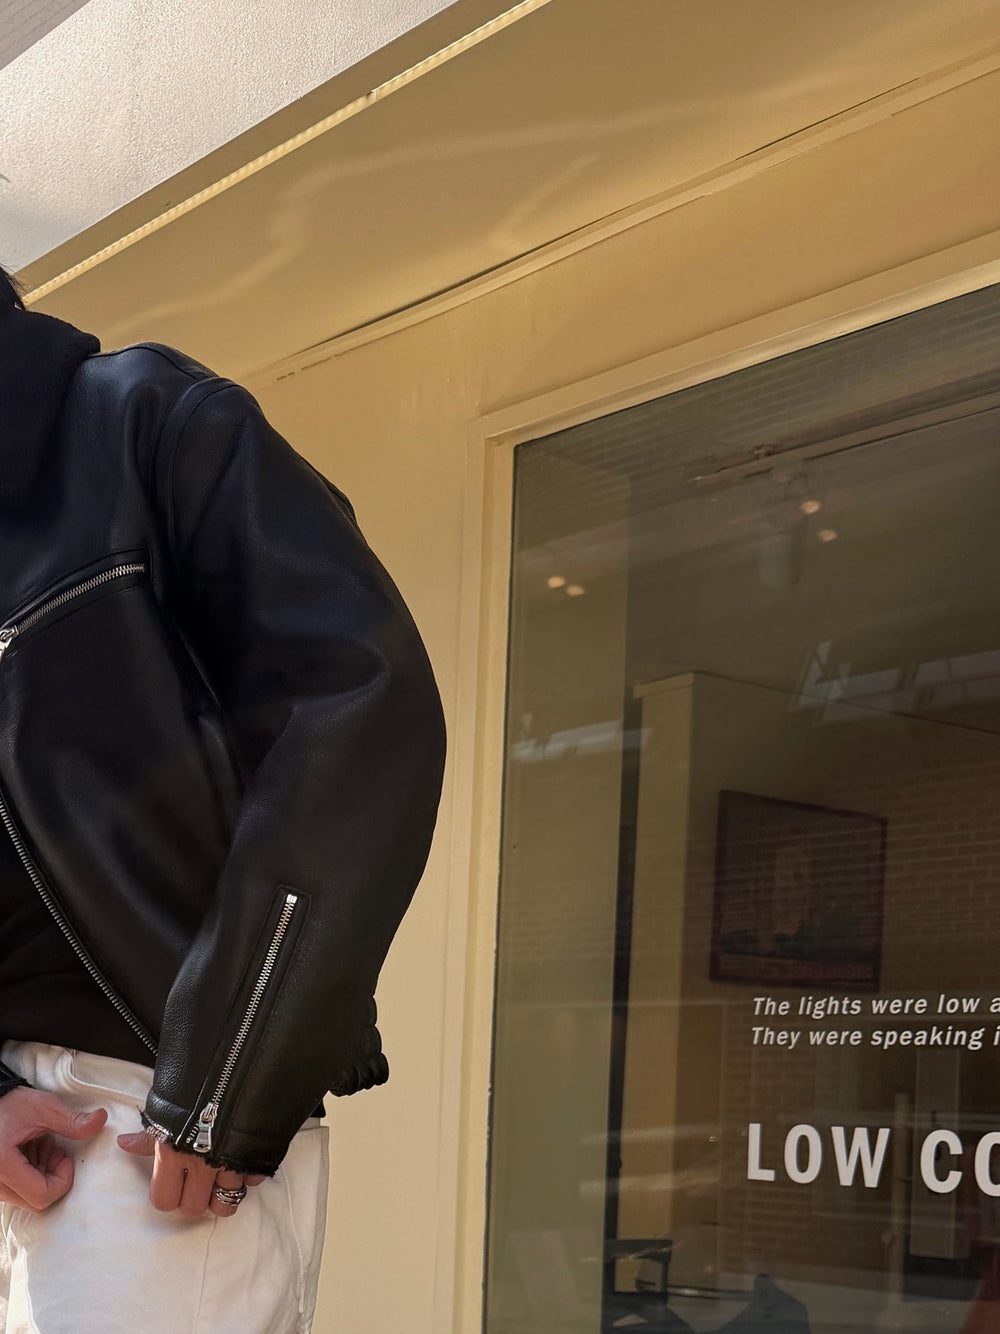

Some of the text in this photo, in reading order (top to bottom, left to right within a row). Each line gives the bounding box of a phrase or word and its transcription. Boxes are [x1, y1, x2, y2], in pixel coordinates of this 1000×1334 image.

[753, 997, 790, 1016] The
[798, 996, 862, 1019] lights
[871, 998, 928, 1015] were
[937, 994, 980, 1014] low
[751, 1026, 800, 1049] They
[809, 1027, 863, 1045] were
[870, 1026, 986, 1050] speaking
[747, 1123, 890, 1188] LOW
